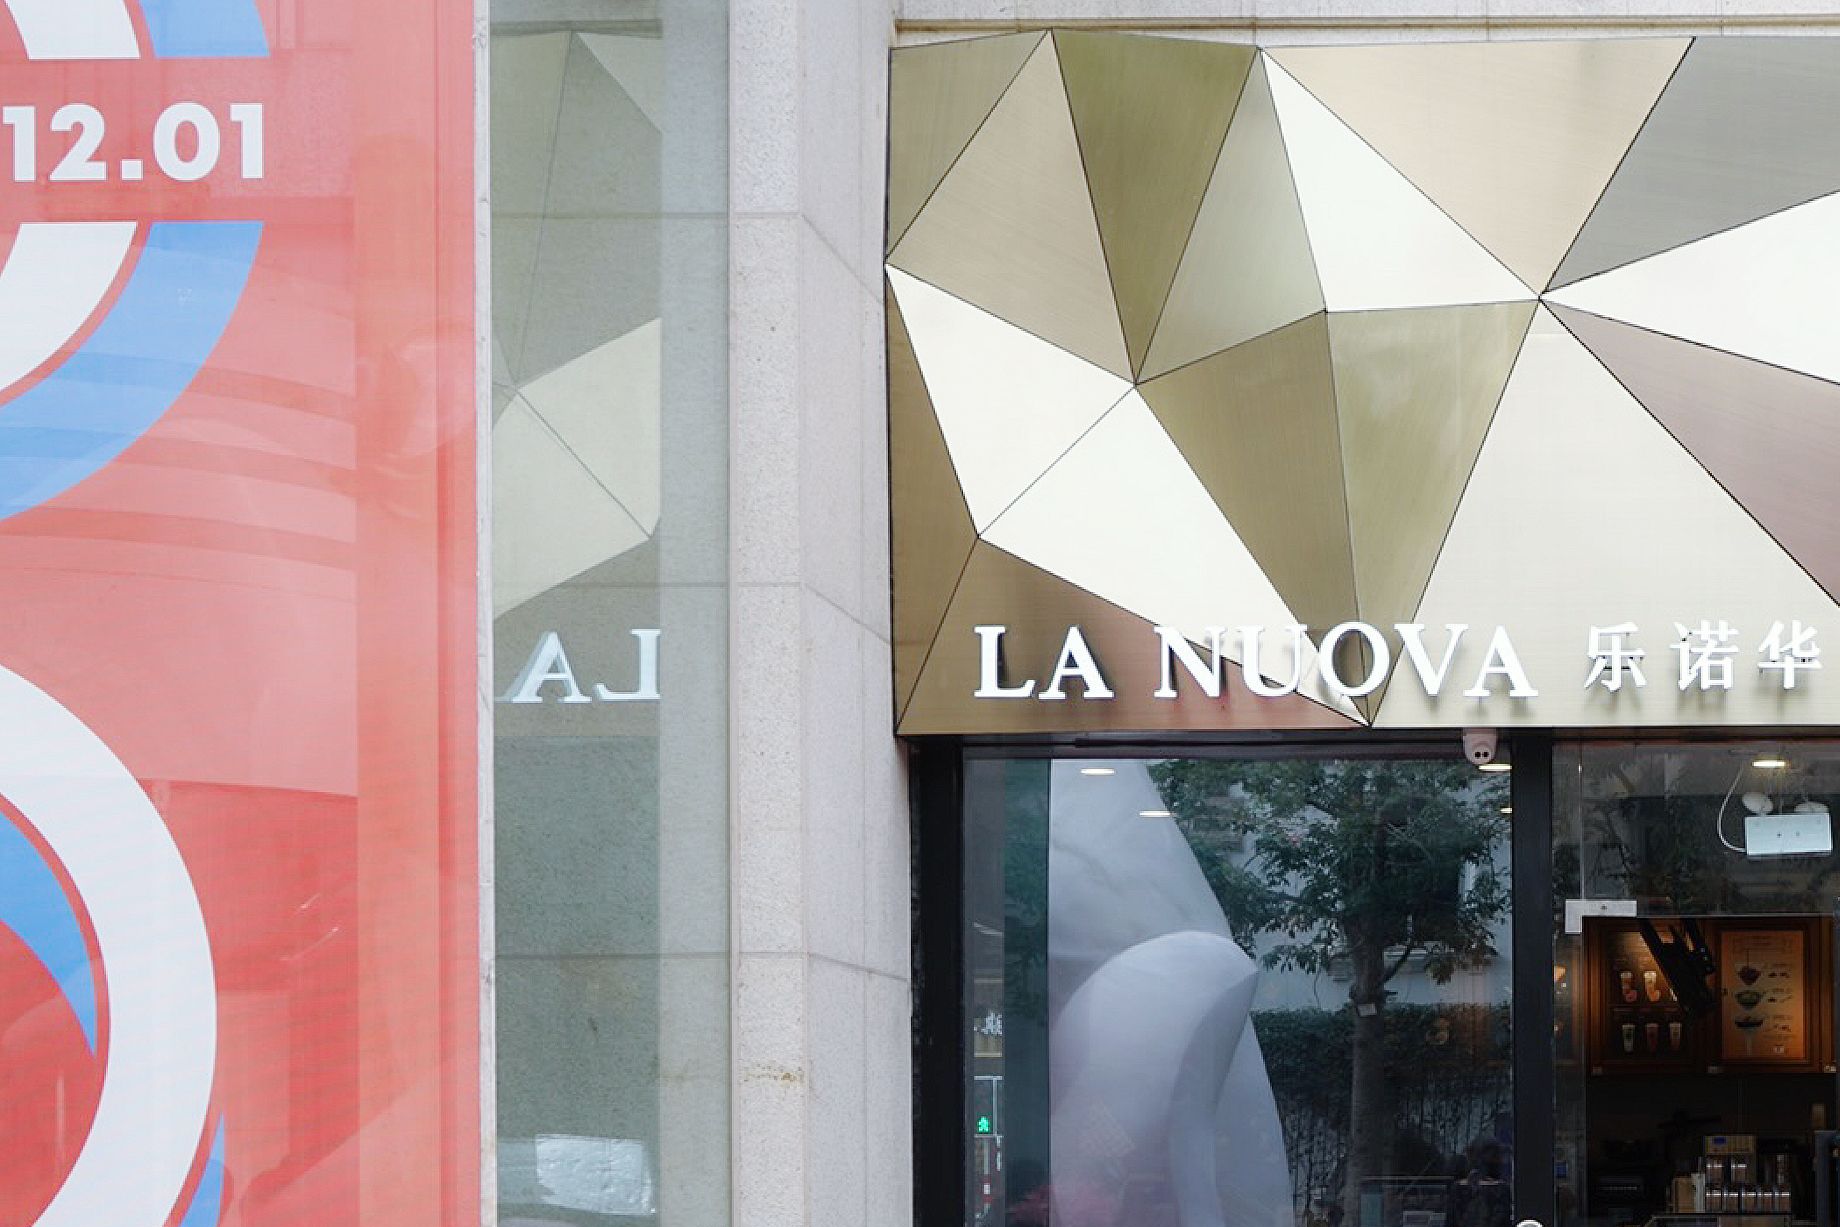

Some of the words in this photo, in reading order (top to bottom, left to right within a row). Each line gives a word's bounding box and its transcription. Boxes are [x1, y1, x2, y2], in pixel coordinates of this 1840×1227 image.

[3, 102, 265, 182] 12.01
[973, 625, 1114, 702] LA
[1153, 620, 1539, 702] NUOVA
[1583, 618, 1824, 694] 乐诺华
